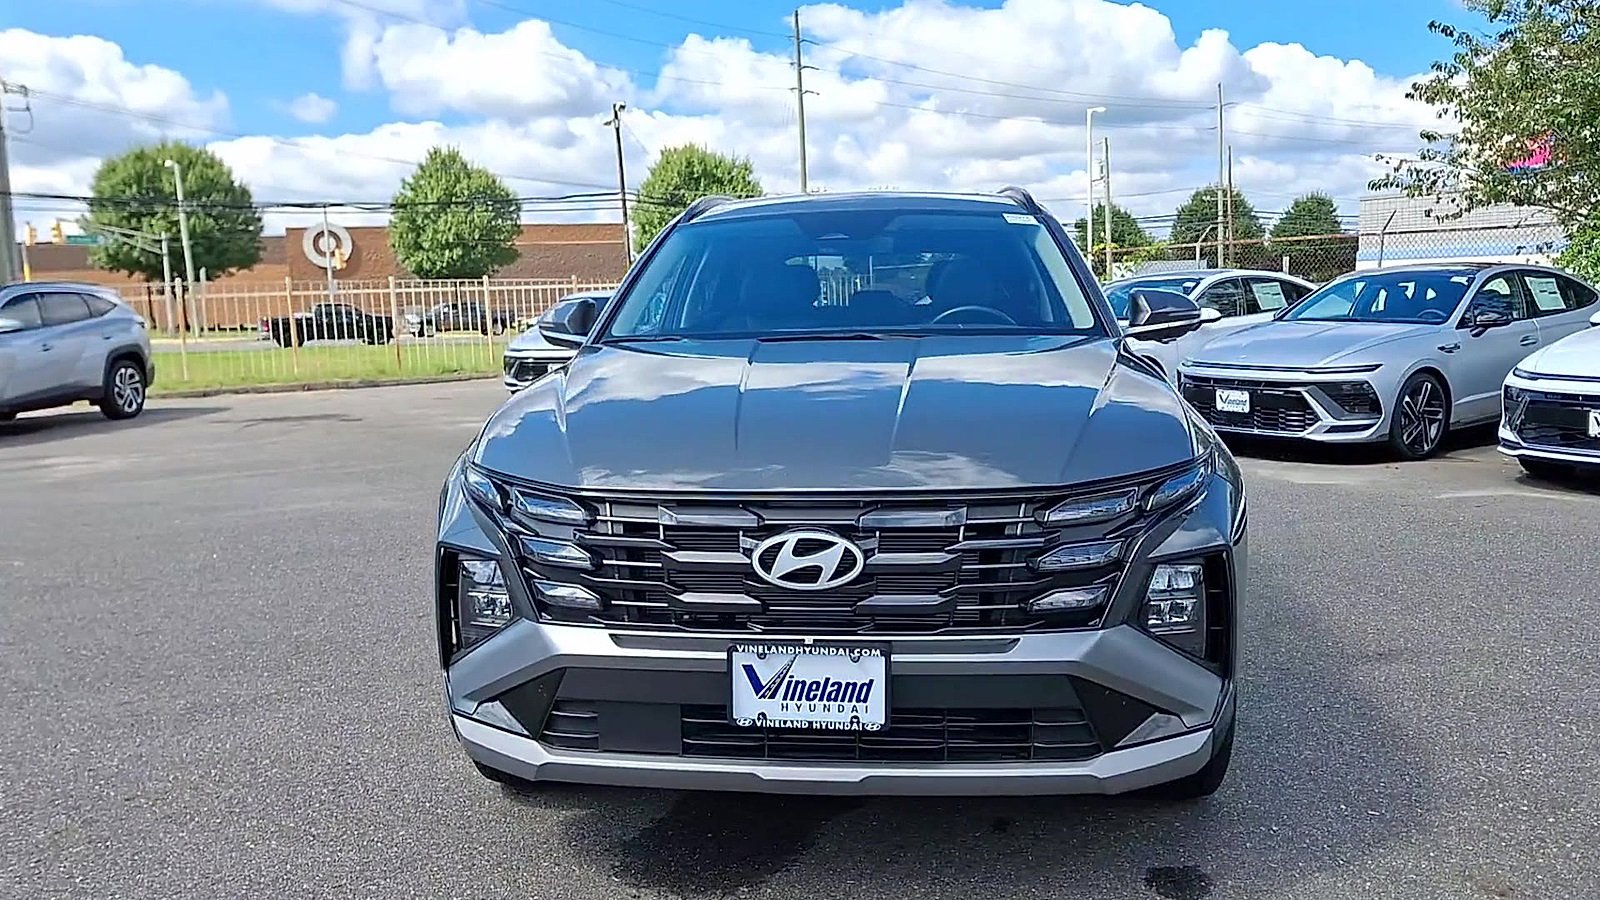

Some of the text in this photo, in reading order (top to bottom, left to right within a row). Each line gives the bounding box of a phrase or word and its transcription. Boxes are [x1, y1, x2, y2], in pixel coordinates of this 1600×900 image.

[736, 645, 881, 657] VINELANDHYUNDAI.COM
[741, 654, 875, 704] Vineland
[780, 703, 869, 714] HYUNDAI
[755, 718, 863, 732] VINELAND HYUNDAI
